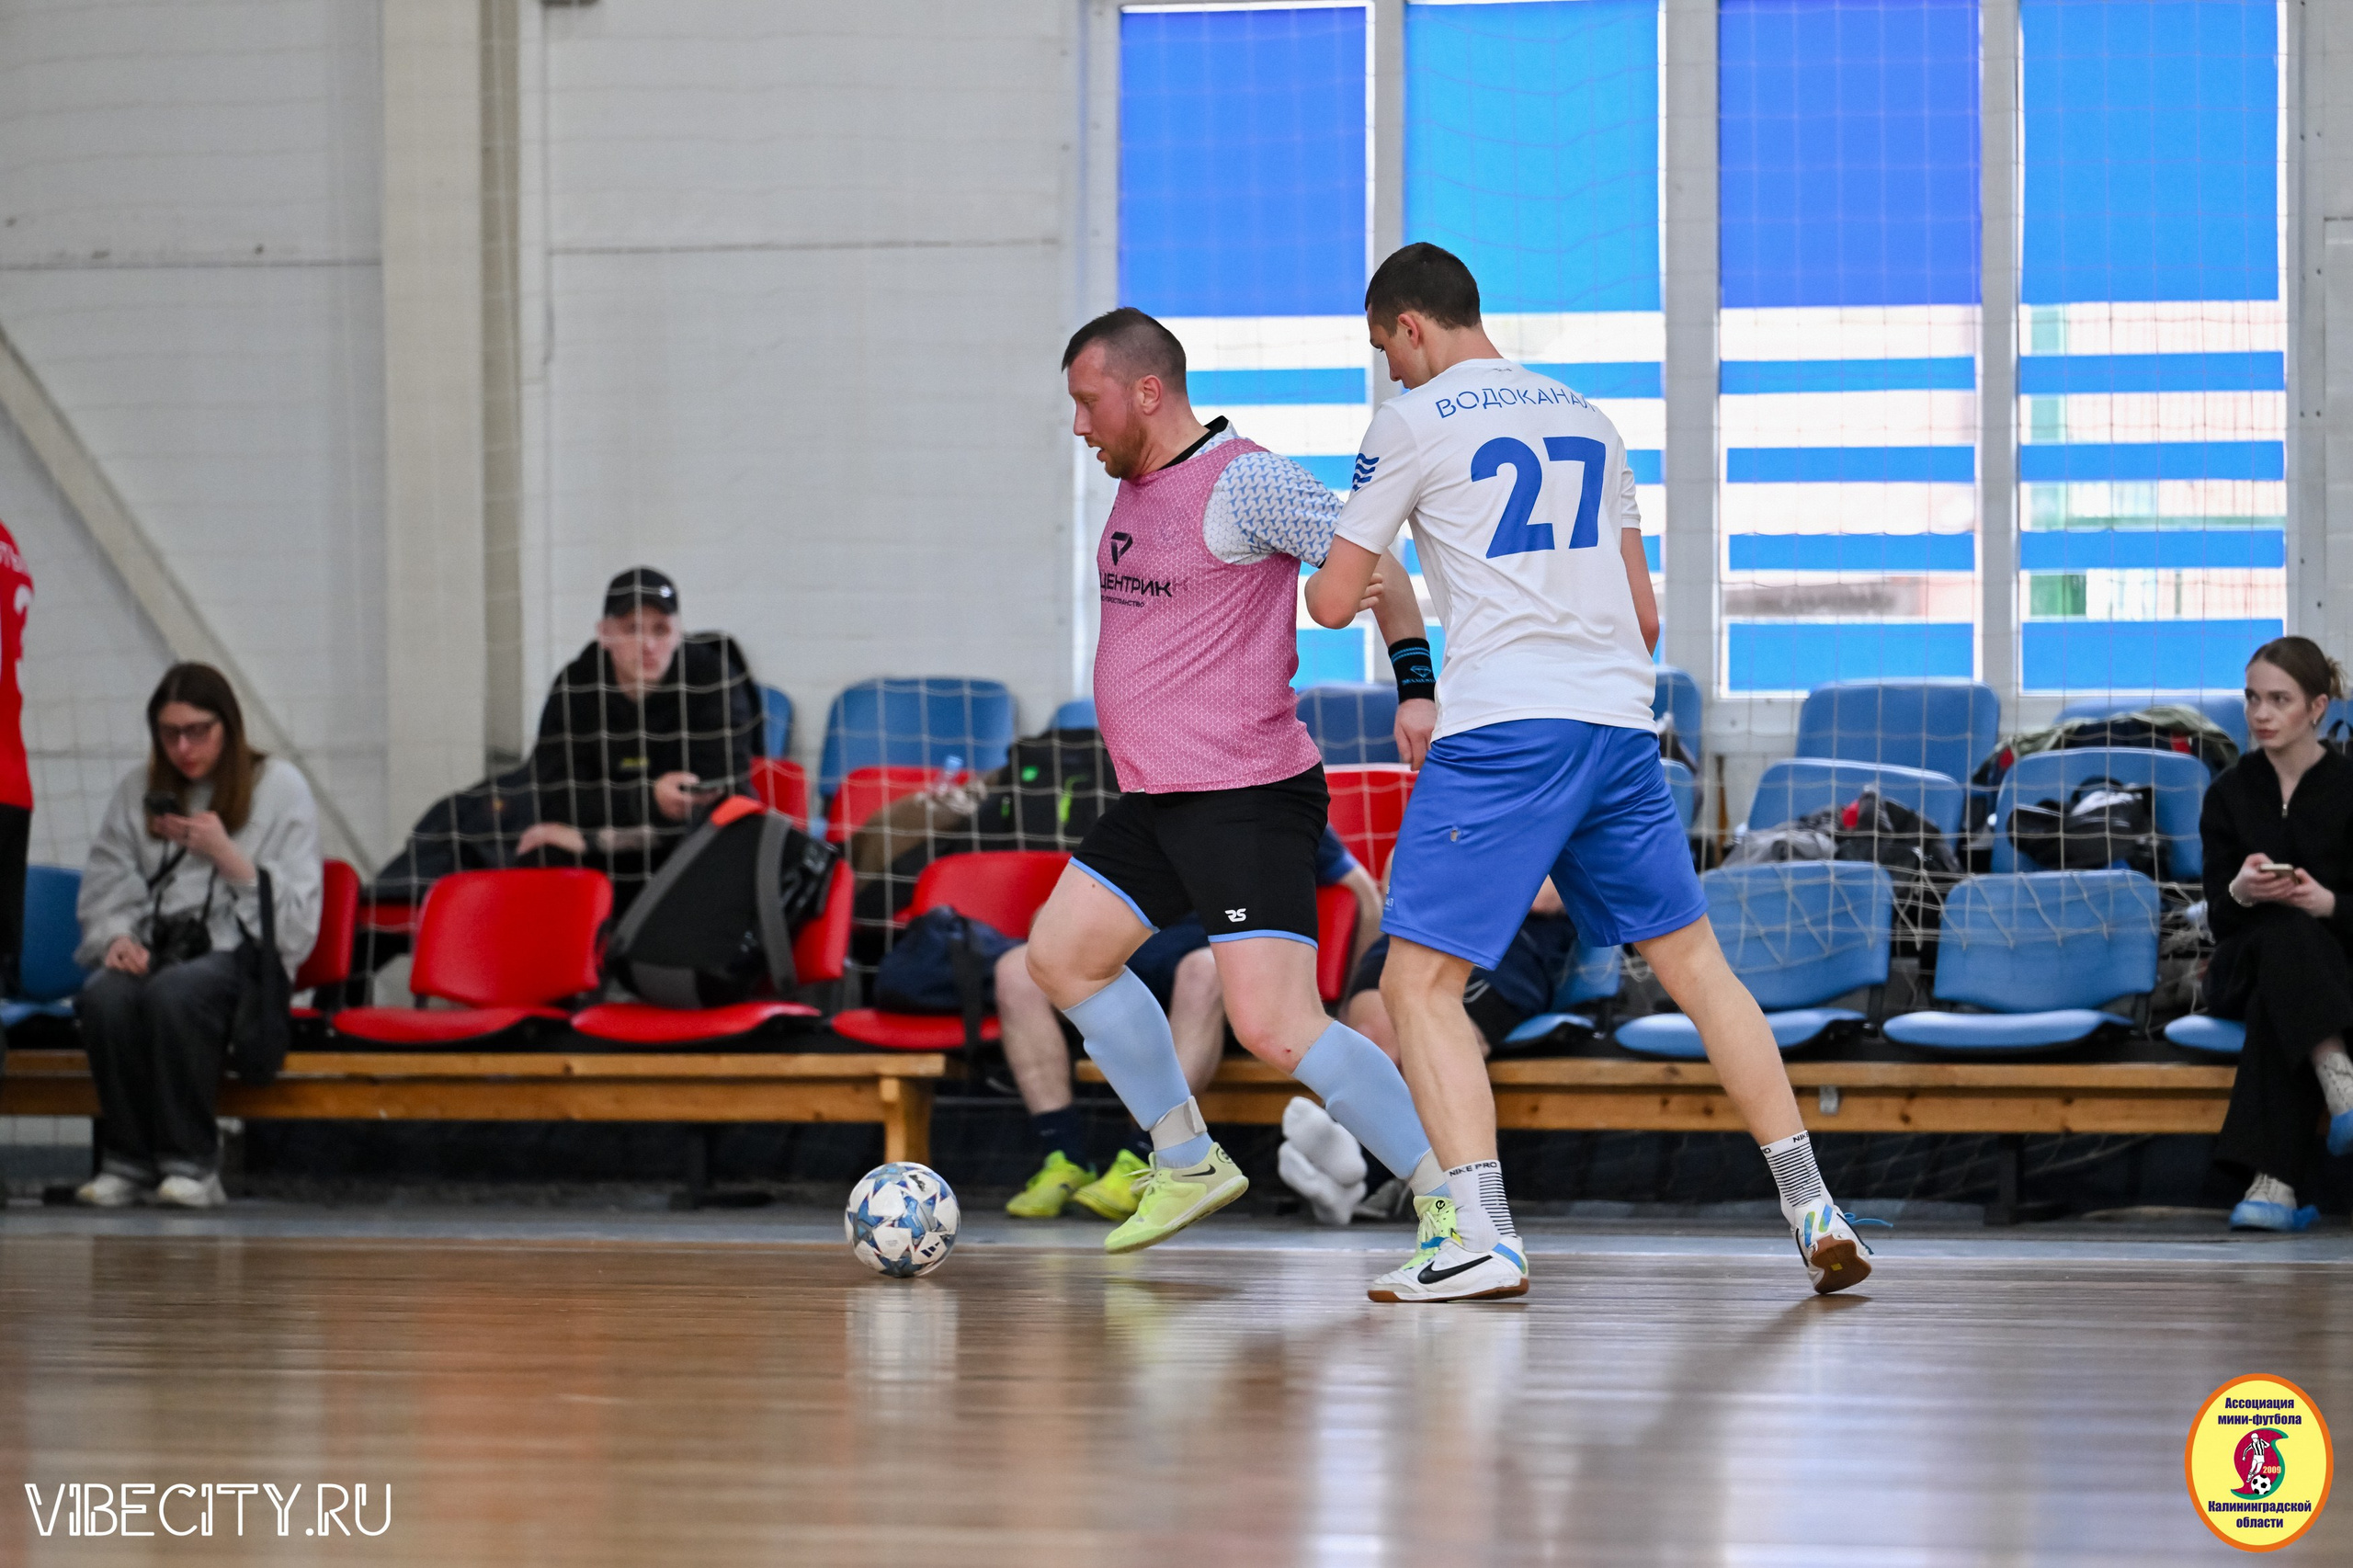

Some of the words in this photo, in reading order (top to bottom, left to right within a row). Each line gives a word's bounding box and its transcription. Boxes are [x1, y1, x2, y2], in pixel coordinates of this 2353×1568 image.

[1436, 387, 1596, 419] ВОДОКАНАЛ
[1471, 436, 1606, 559] 27
[1449, 1165, 1472, 1176] NIKE
[1474, 1161, 1497, 1170] PRO
